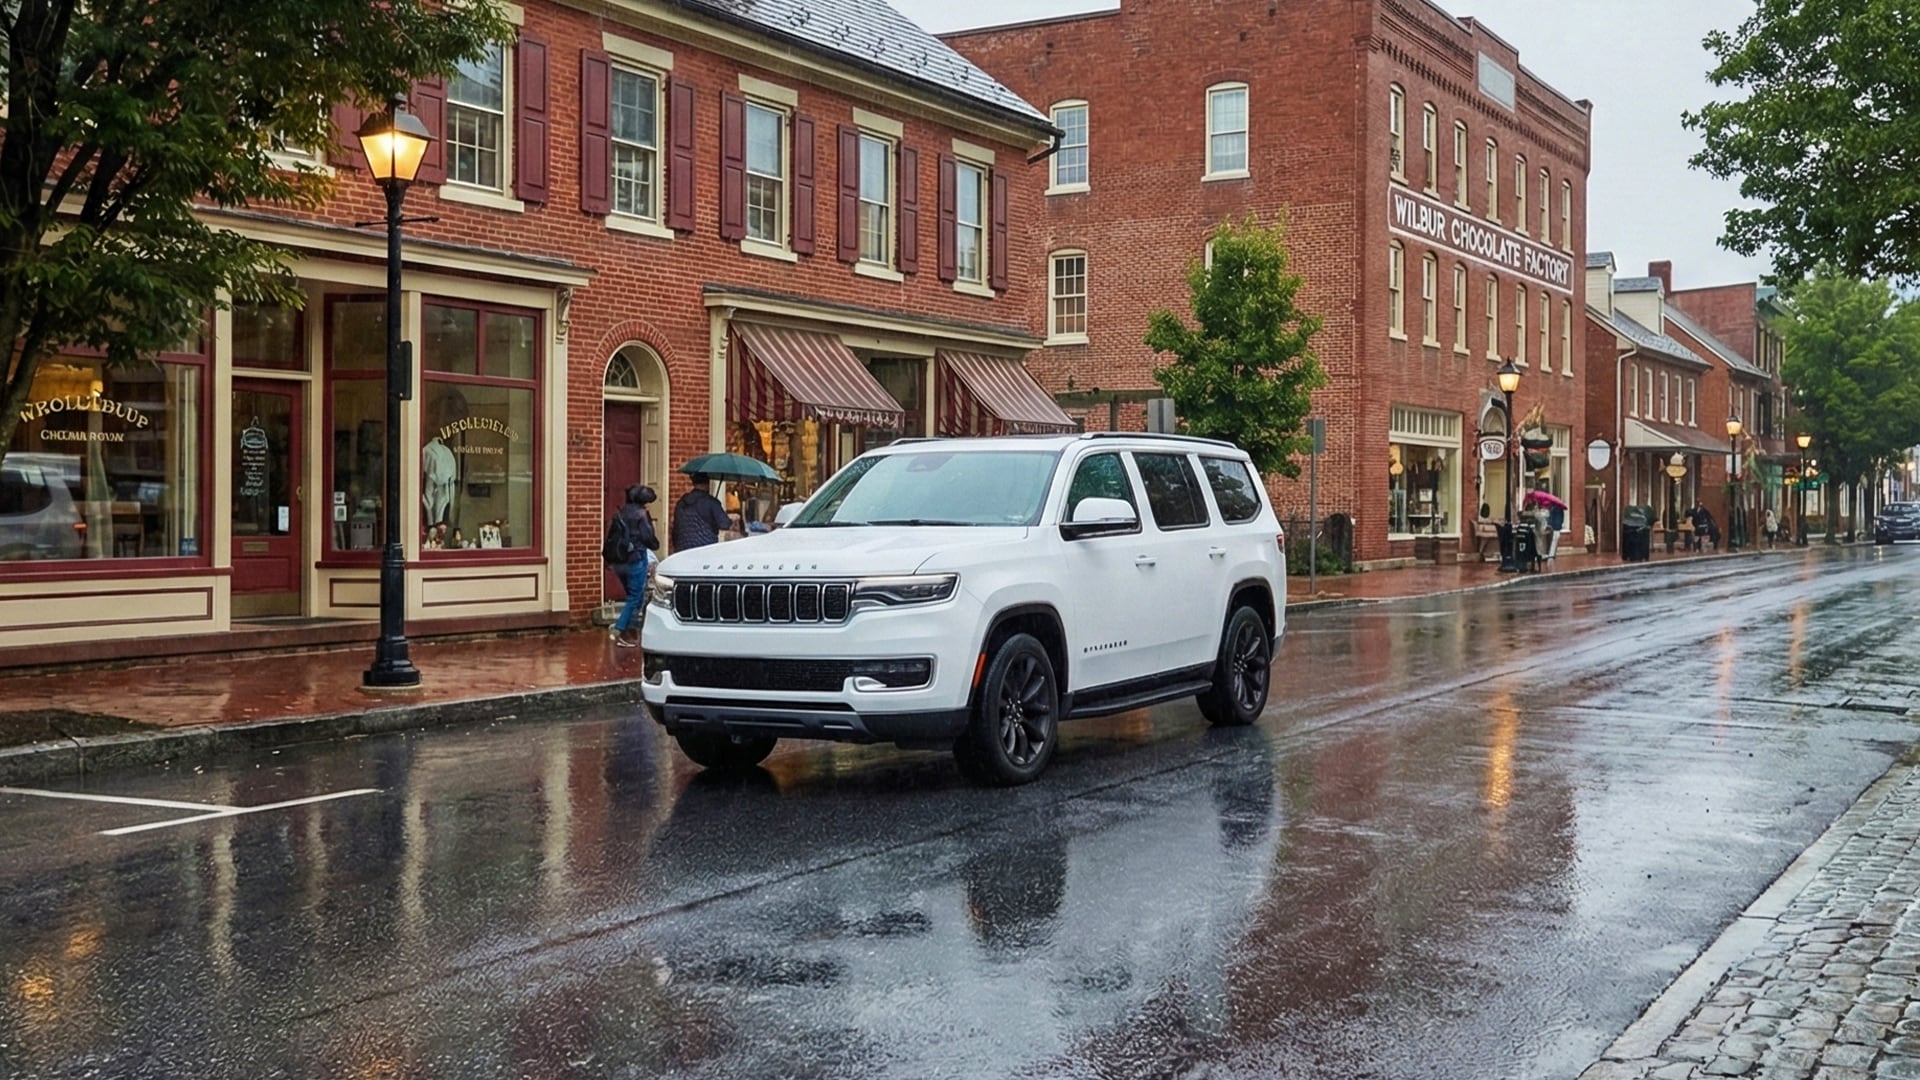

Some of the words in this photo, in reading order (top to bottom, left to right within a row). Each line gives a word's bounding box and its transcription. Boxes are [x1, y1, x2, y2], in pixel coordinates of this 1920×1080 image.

[1394, 193, 1446, 241] WILBUR
[1451, 218, 1521, 267] CHOCOLATE
[1524, 246, 1570, 285] FACTORY
